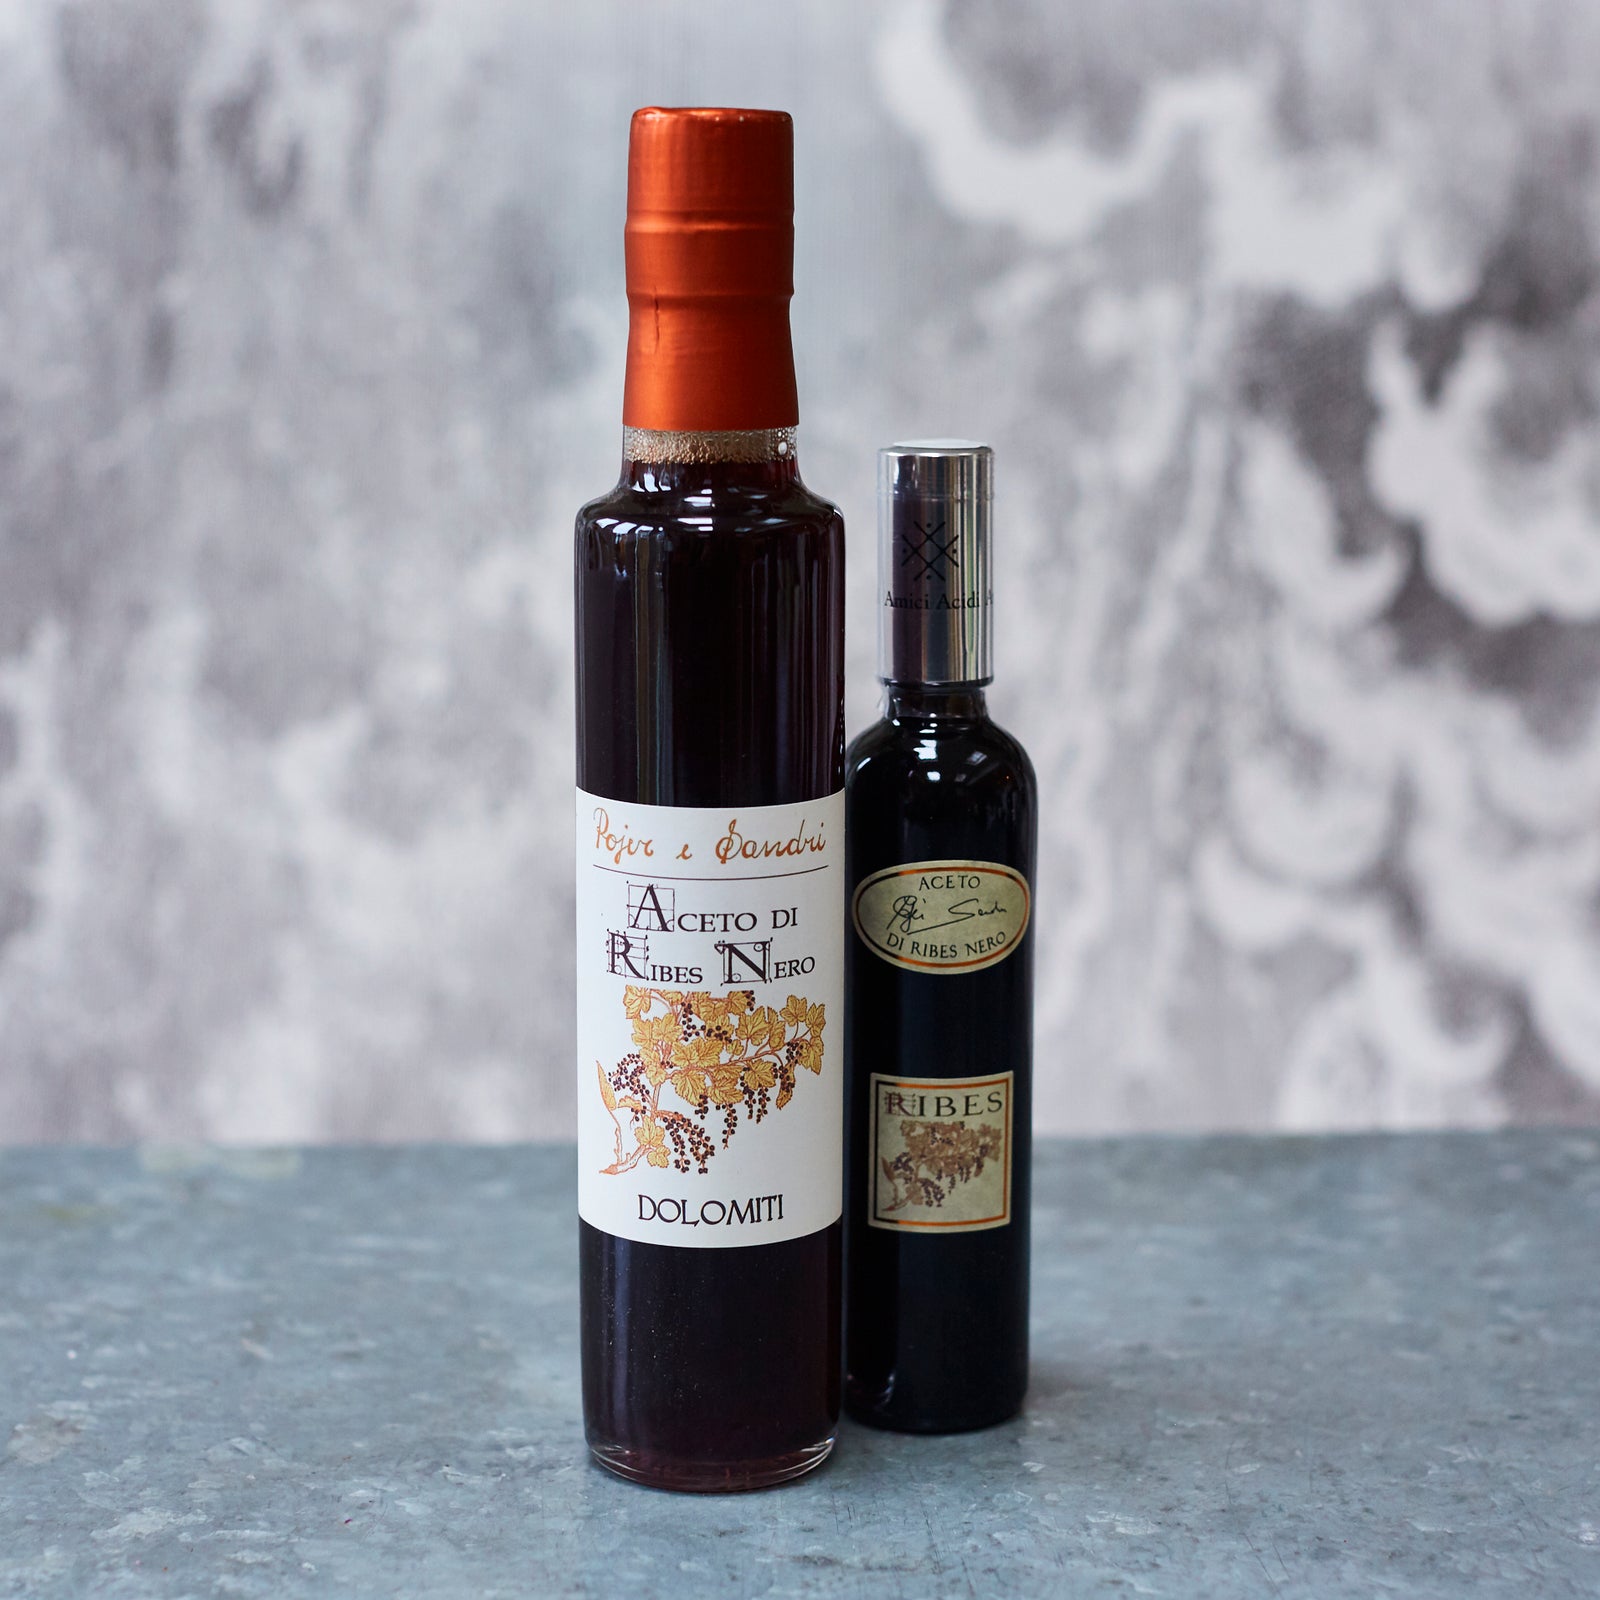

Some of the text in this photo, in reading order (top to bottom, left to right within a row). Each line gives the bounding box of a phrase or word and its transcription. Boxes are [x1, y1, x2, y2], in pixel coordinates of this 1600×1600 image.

[884, 591, 929, 609] Amici
[936, 591, 980, 609] Acidi
[593, 807, 654, 865] Pojer
[715, 819, 827, 864] Sandri
[918, 875, 981, 891] ACETO
[626, 882, 798, 932] ACETO DI
[606, 929, 816, 986] RIBES NERO
[886, 931, 1006, 959] DI RIBES NERO
[884, 1090, 1003, 1118] RIBES
[637, 1194, 784, 1227] DOLOMITI
